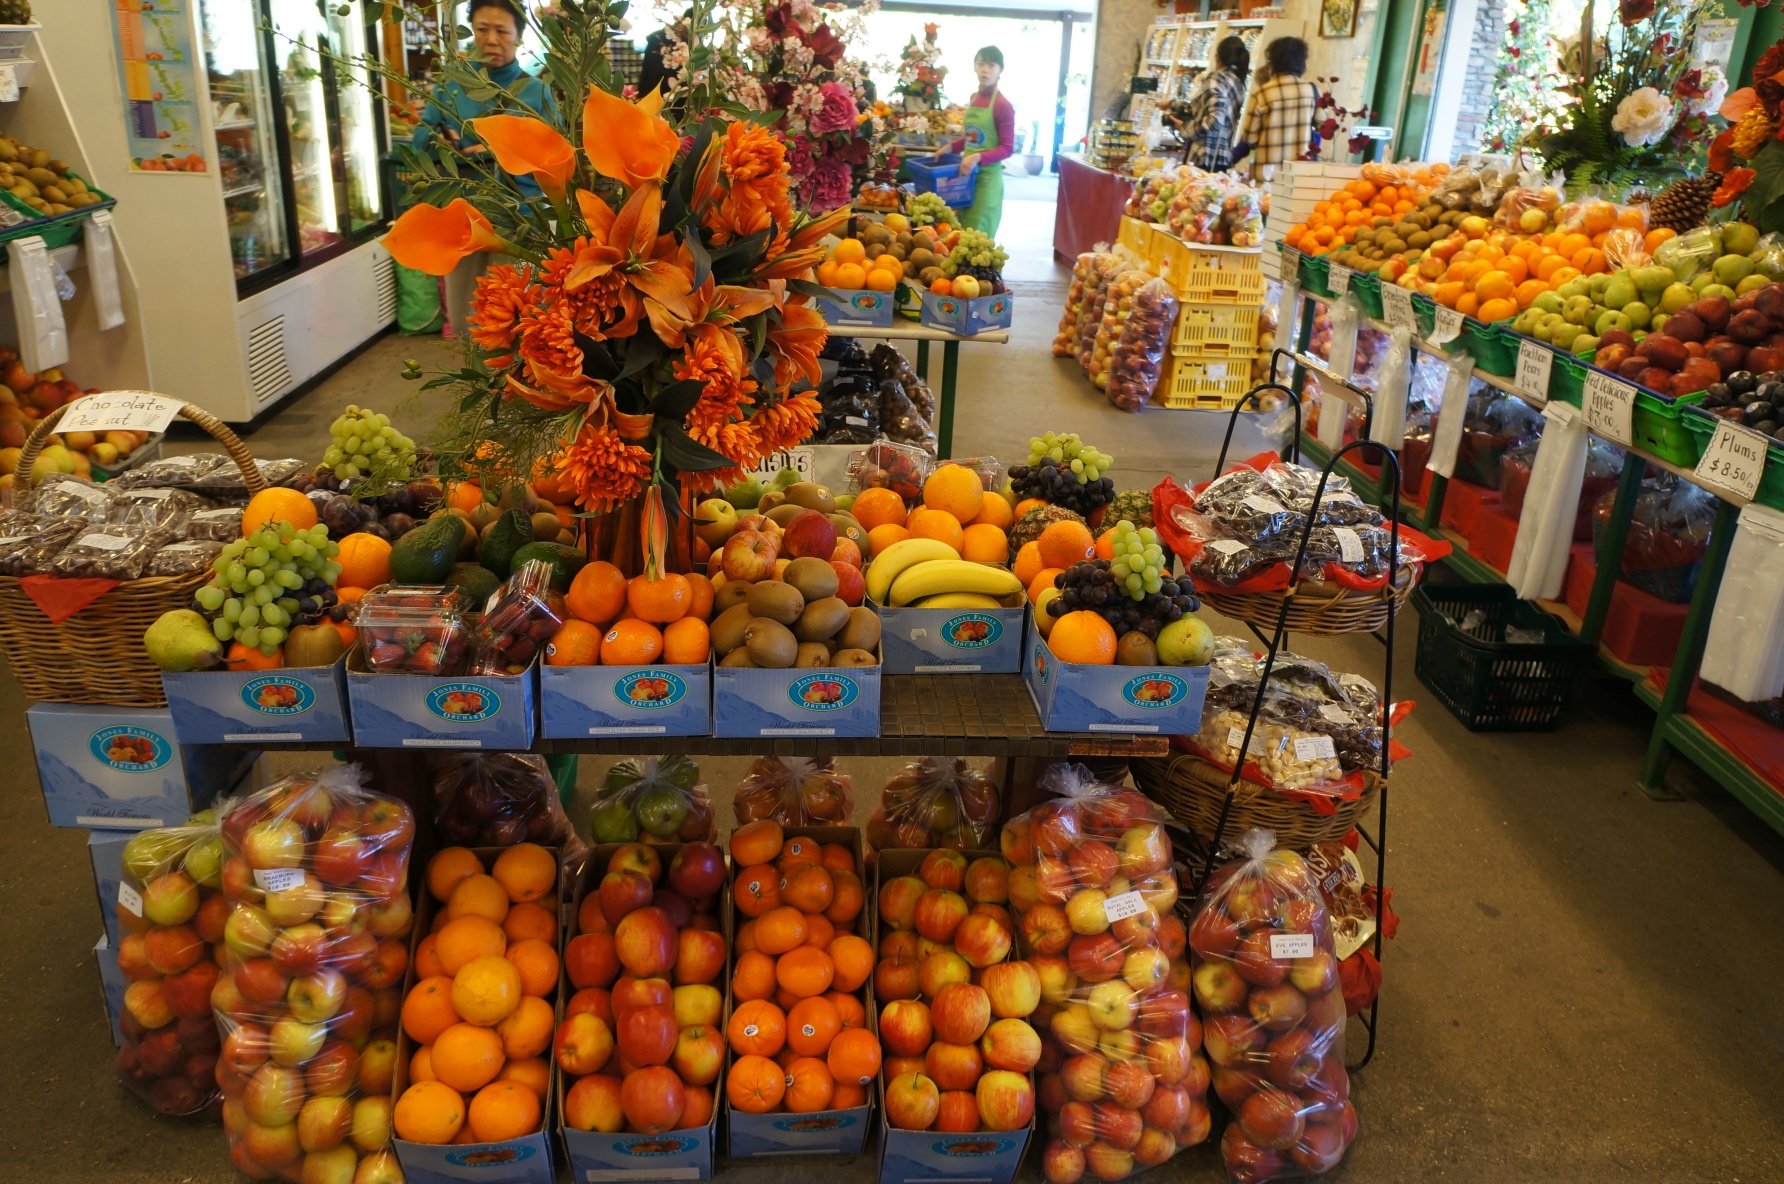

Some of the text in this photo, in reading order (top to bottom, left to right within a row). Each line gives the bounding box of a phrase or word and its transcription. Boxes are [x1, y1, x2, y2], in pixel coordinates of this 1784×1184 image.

[1523, 360, 1541, 376] Pears
[1586, 373, 1630, 404] Red Delicious
[76, 396, 166, 410] Chocolate
[1592, 391, 1614, 411] Apples
[66, 413, 132, 427] Peanut
[1719, 432, 1757, 461] Plums
[948, 614, 997, 626] JONES FAMILY
[246, 677, 306, 691] JONES FAMILY
[621, 671, 679, 684] JONES FAMILY
[796, 675, 852, 687] JONES FAMILY
[1131, 674, 1182, 686] JONES FAMILY
[433, 685, 492, 697] JONES FAMILY
[260, 705, 303, 713] ORCHARD
[96, 727, 161, 742] JONES FAMILY
[109, 760, 158, 770] ORCHARD
[87, 807, 151, 819] World Famous
[1116, 904, 1135, 912] APPLES
